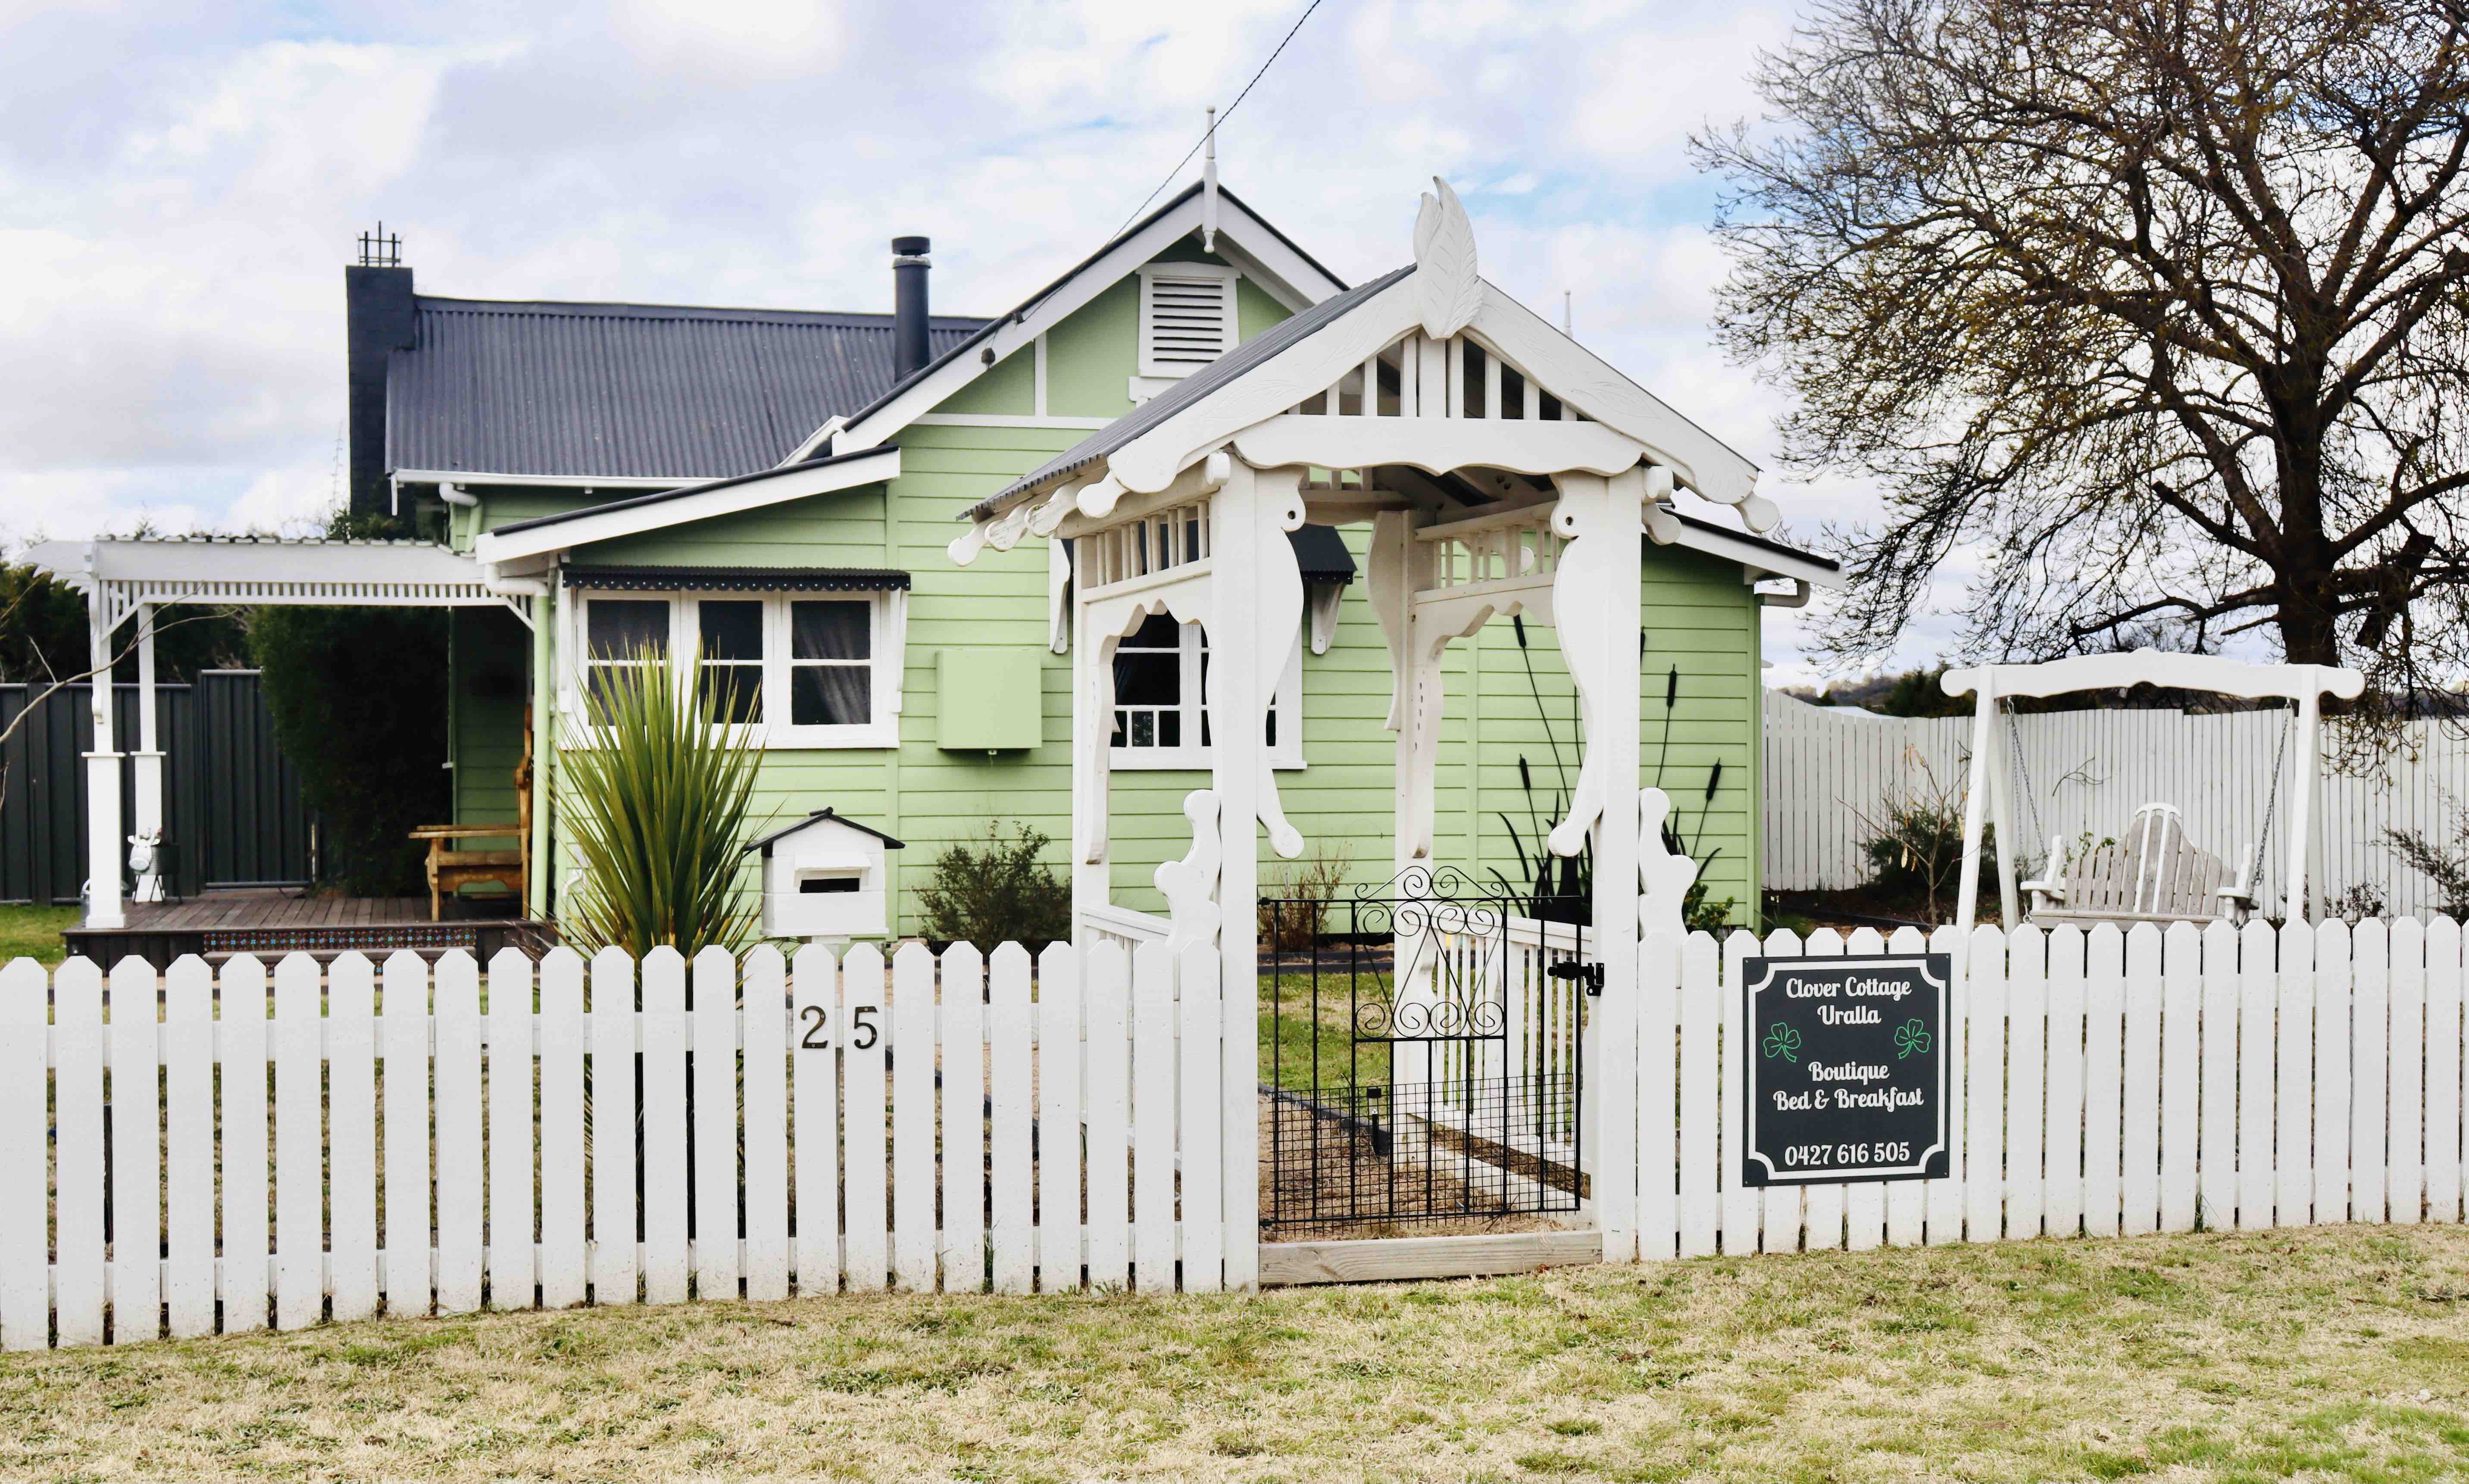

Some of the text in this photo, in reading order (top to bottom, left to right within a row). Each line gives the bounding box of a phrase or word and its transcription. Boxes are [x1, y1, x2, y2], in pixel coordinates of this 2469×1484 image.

[1786, 976, 1912, 1001] Clover Cottage
[1817, 1005, 1882, 1025] Uralla
[1808, 1061, 1890, 1086] Boutique
[1772, 1086, 1924, 1112] Bed & Breakfast
[1785, 1141, 1910, 1166] 0427 616 505
